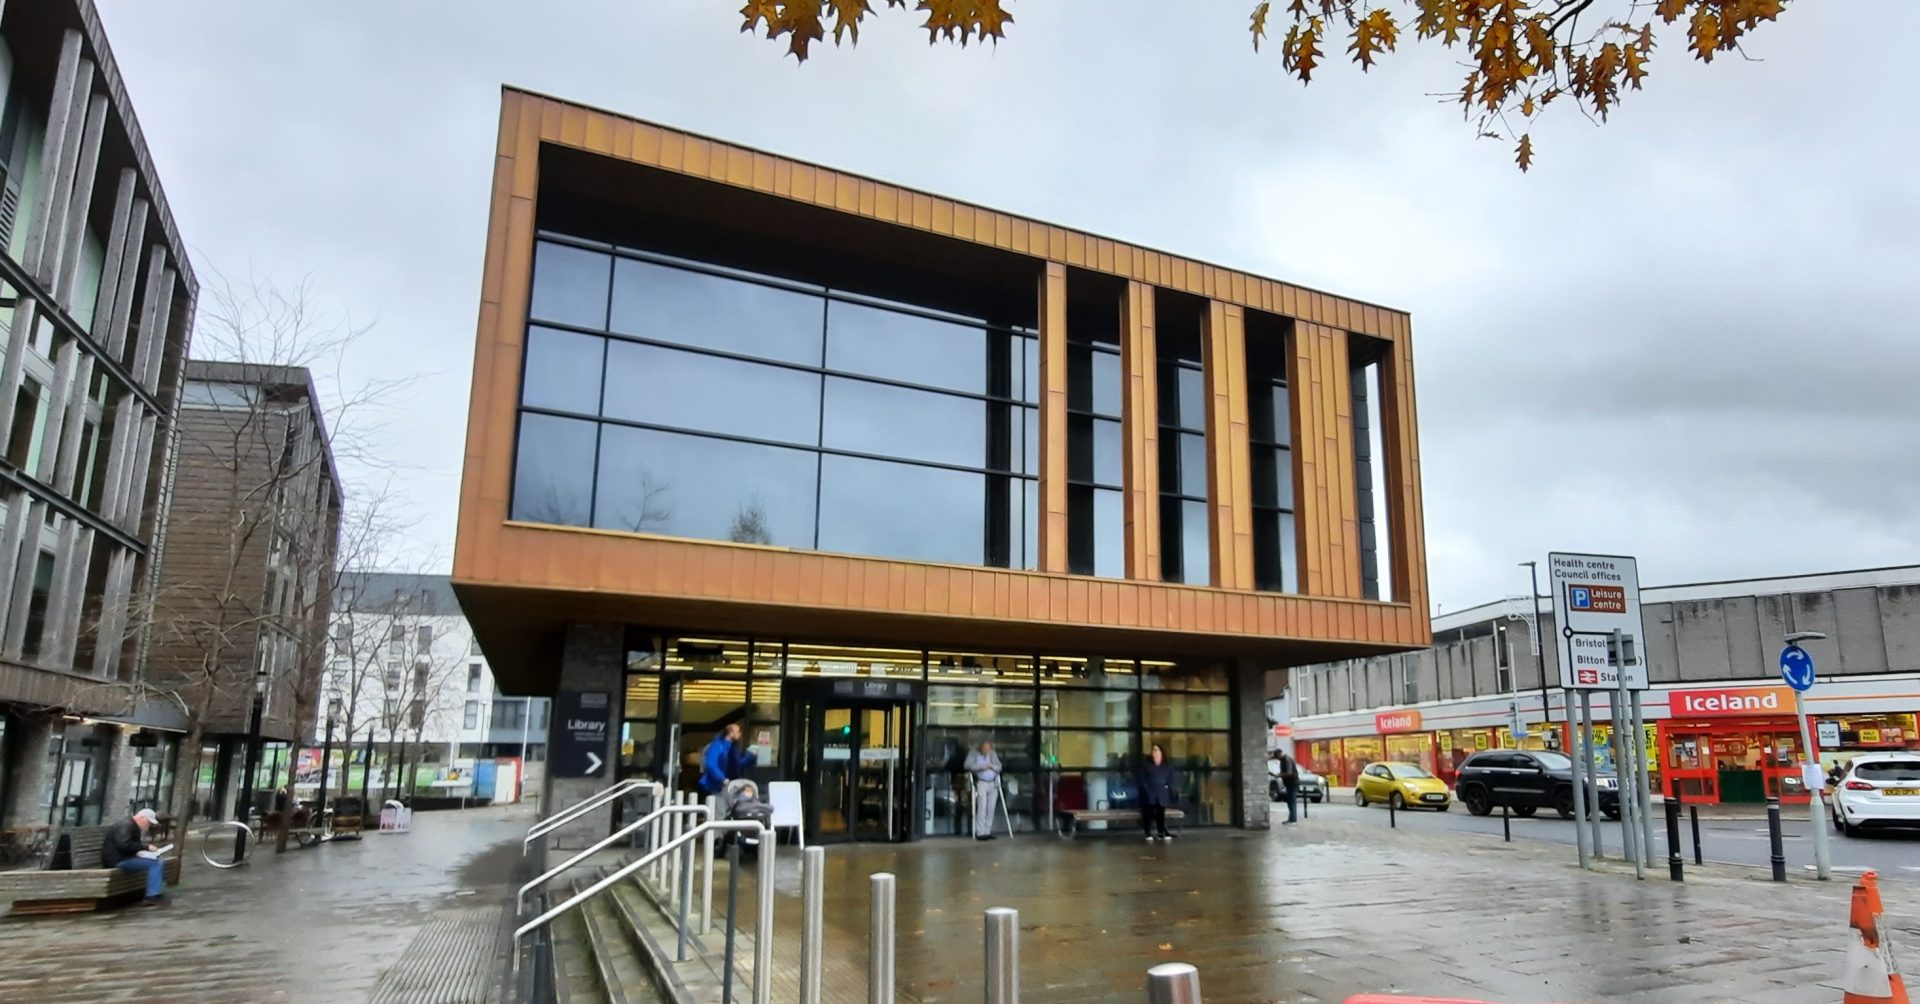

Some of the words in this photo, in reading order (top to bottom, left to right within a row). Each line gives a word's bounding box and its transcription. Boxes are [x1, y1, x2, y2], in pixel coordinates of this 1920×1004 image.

[1554, 558, 1583, 568] Health
[1586, 560, 1615, 570] centre
[1554, 569, 1589, 579] Council
[1591, 571, 1621, 581] offices
[1591, 588, 1622, 599] Leisure
[1593, 599, 1621, 609] centre
[1576, 639, 1606, 648] Bristol
[1577, 655, 1605, 664] Bitton
[1600, 672, 1634, 682] Statn
[864, 681, 888, 691] Library
[1685, 692, 1777, 711] Iceland
[567, 719, 606, 732] Library
[1380, 715, 1412, 729] Iceland
